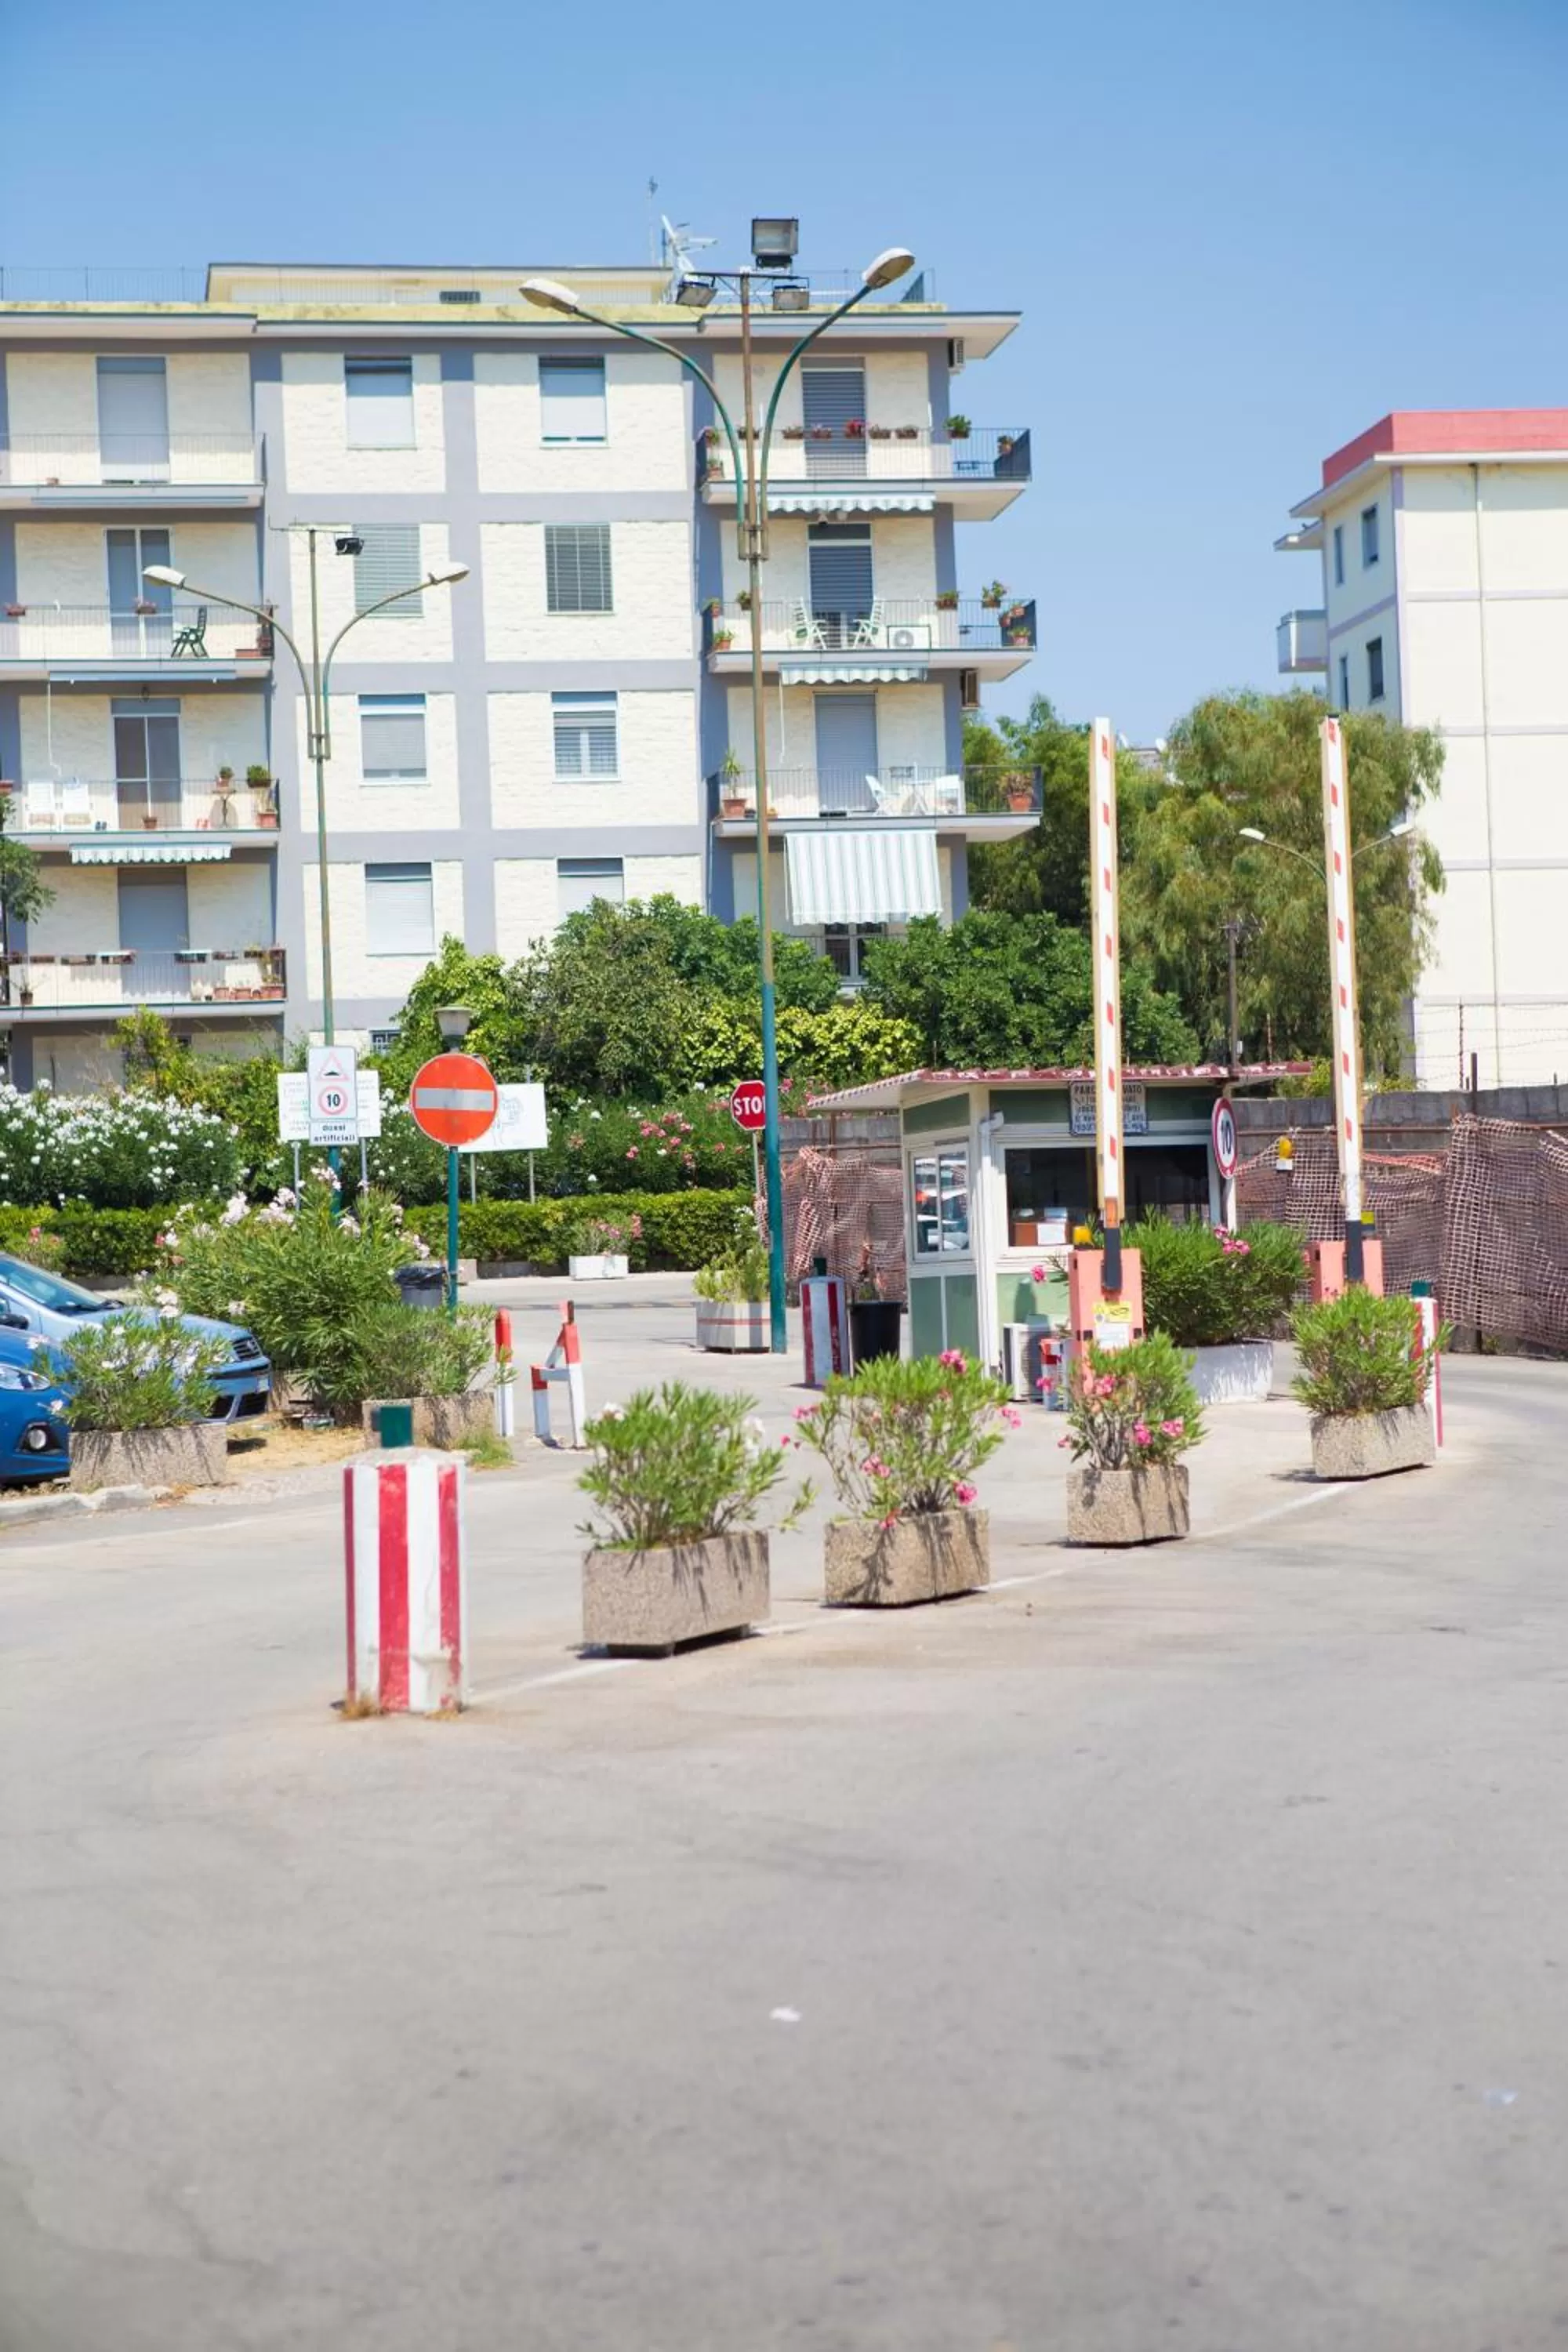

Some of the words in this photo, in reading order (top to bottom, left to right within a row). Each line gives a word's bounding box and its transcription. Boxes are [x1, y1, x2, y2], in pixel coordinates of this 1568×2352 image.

[326, 1094, 342, 1108] 10
[733, 1096, 766, 1116] STO
[1221, 1119, 1232, 1155] 10
